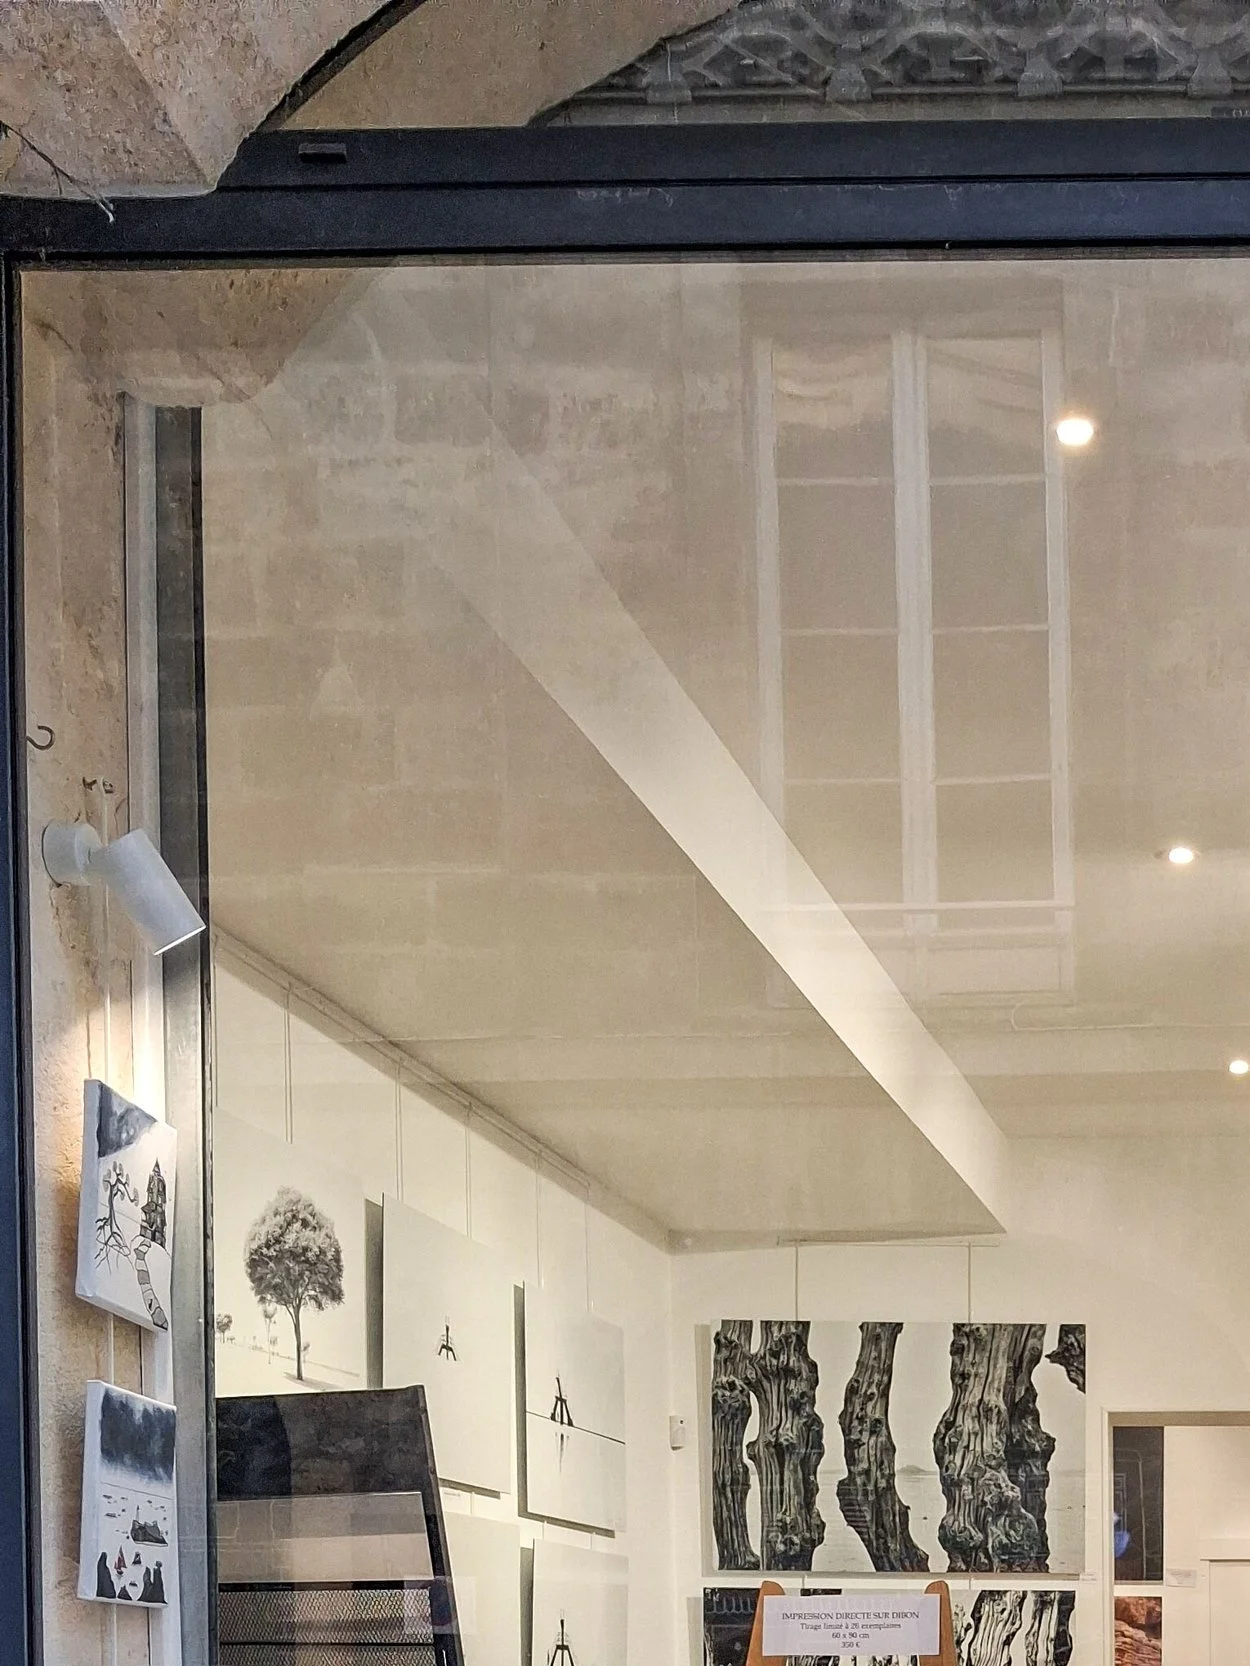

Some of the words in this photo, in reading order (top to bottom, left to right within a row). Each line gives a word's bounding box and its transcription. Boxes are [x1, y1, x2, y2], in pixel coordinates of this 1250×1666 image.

[782, 1612, 834, 1620] IMPRESSION
[836, 1612, 871, 1620] DIRECTE
[800, 1622, 821, 1631] Tirage
[861, 1623, 902, 1631] exemplaires
